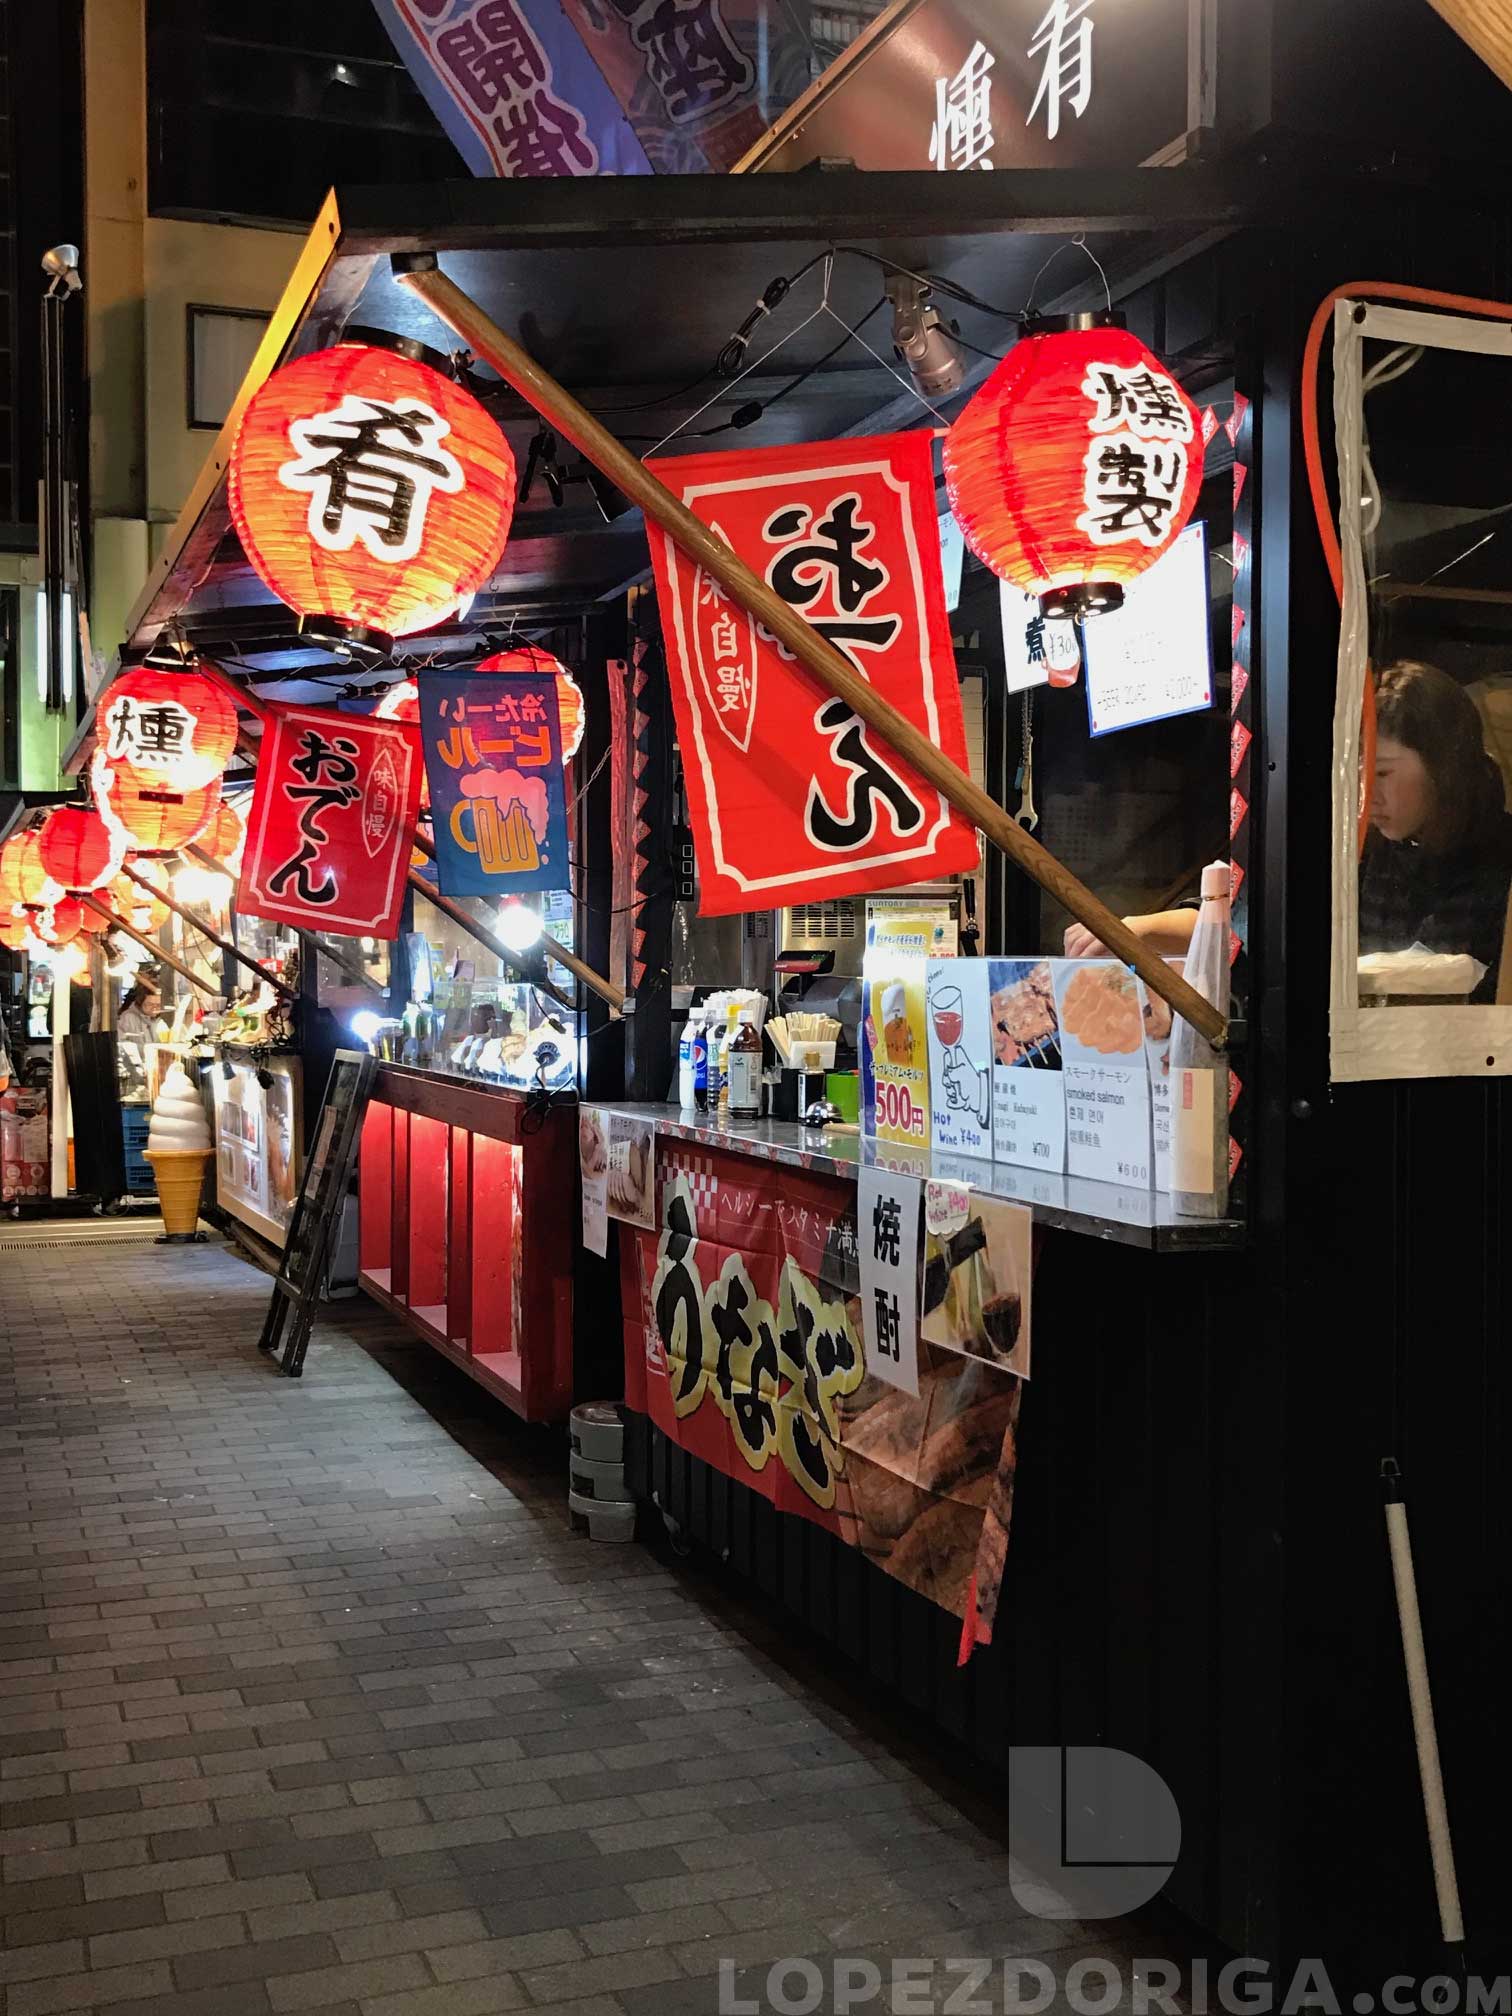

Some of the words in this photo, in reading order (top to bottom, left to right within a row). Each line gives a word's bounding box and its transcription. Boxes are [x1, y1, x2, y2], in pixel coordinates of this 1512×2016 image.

[266, 730, 362, 906] おでん
[365, 767, 394, 839] 味自慢
[875, 1081, 924, 1136] 500円
[1066, 1087, 1096, 1102] smoked
[1097, 1090, 1125, 1105] salmon
[1117, 1162, 1148, 1180] ¥600
[721, 1191, 859, 1258] ヘルシーでスタミナ満
[873, 1194, 902, 1364] 焼酎
